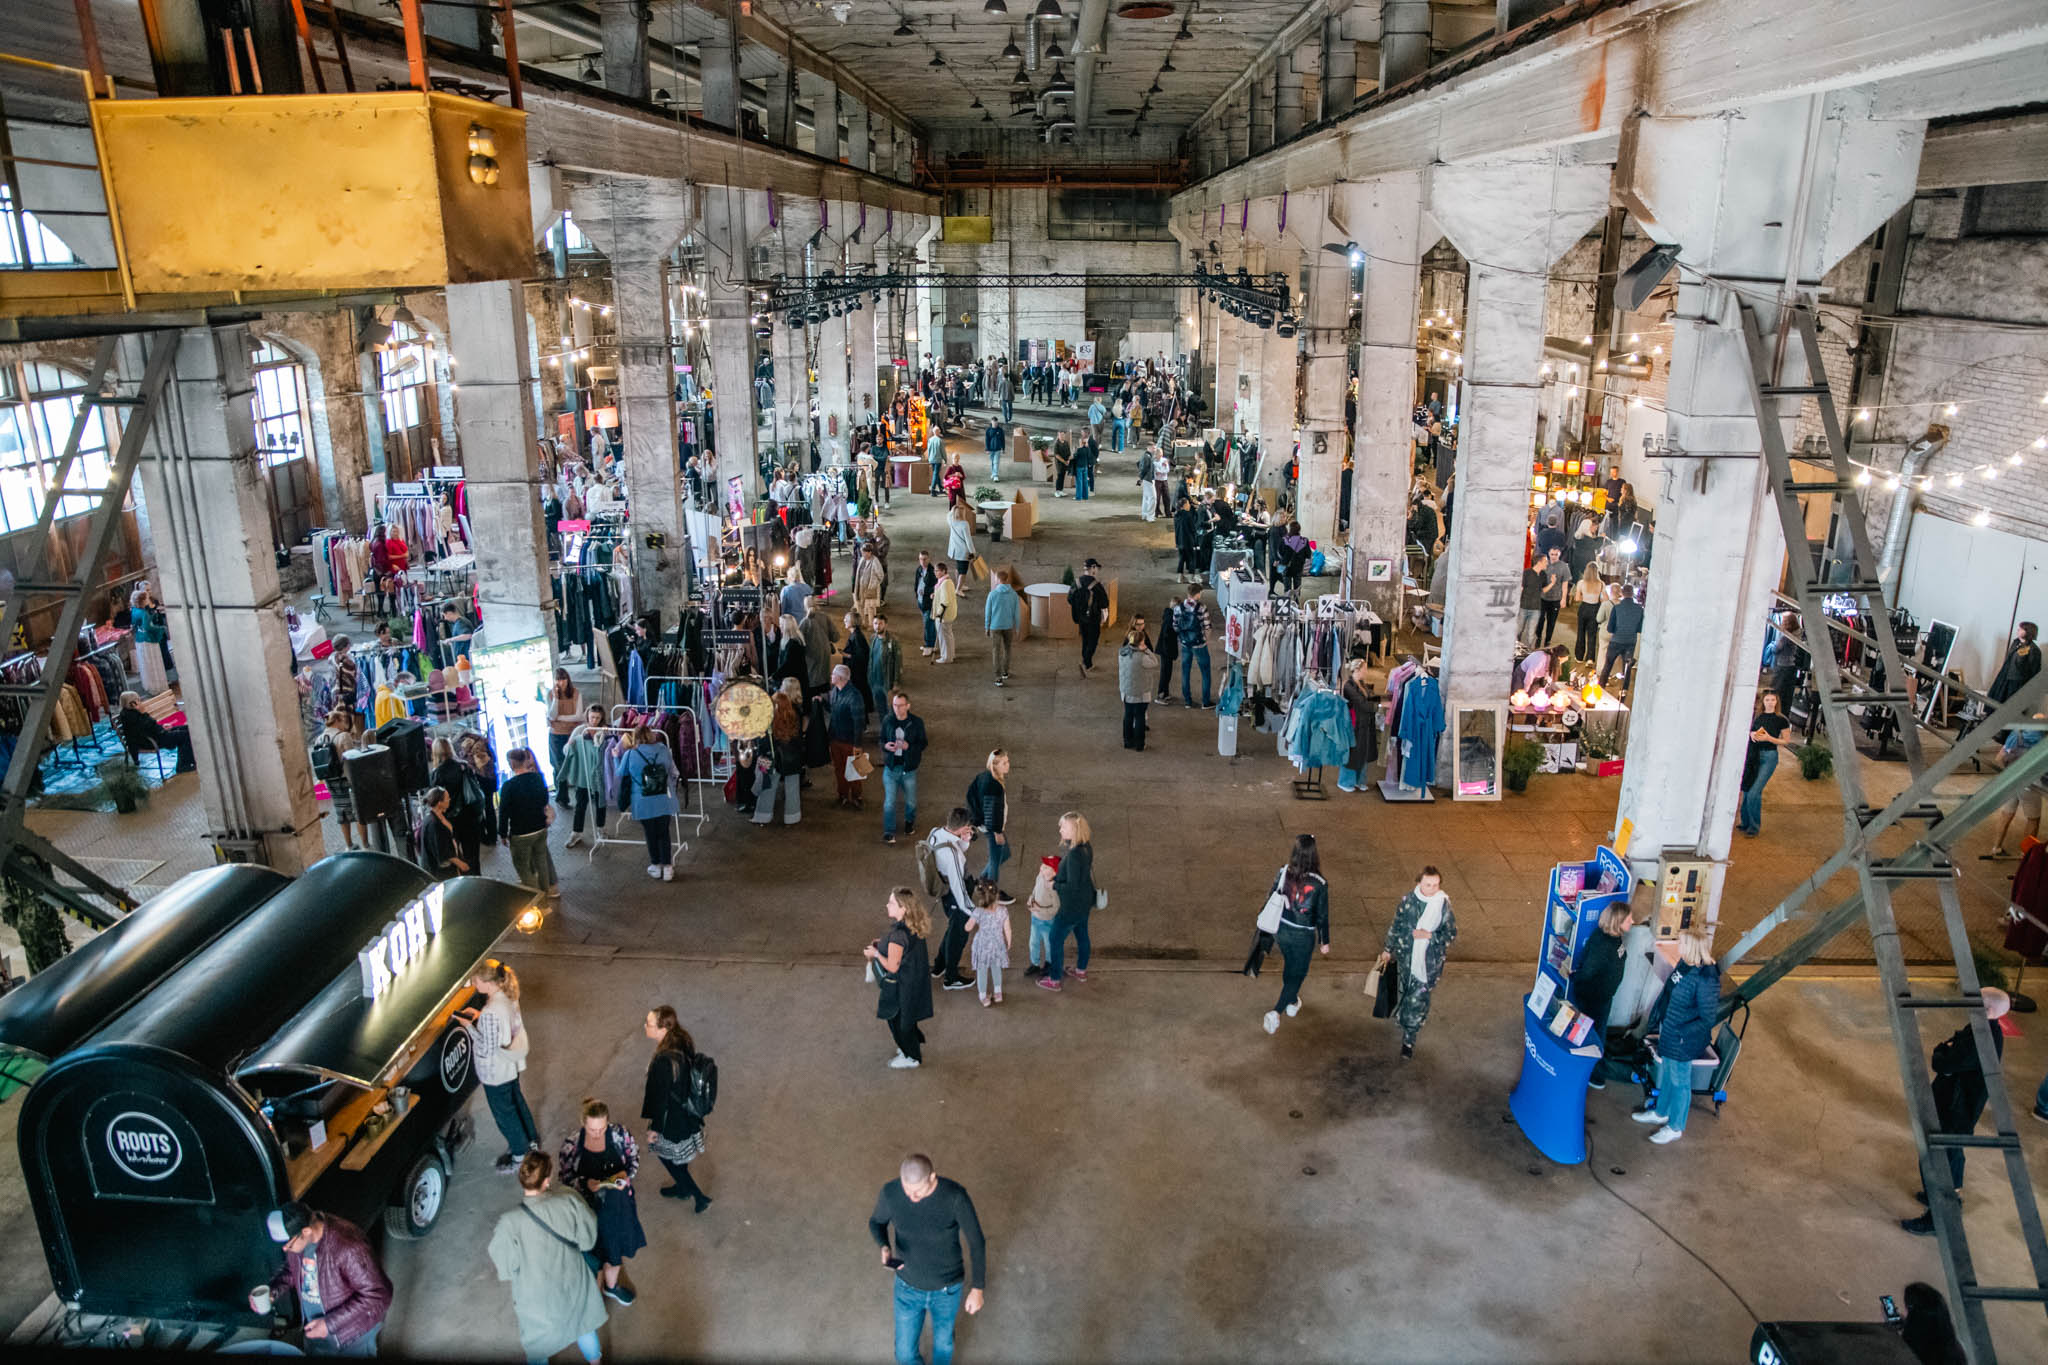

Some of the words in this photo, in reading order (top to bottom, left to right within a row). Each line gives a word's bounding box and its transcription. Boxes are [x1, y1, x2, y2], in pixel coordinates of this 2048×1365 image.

[362, 882, 444, 1001] KOHV
[444, 1037, 467, 1073] ROOTS
[115, 1130, 172, 1154] ROOTS
